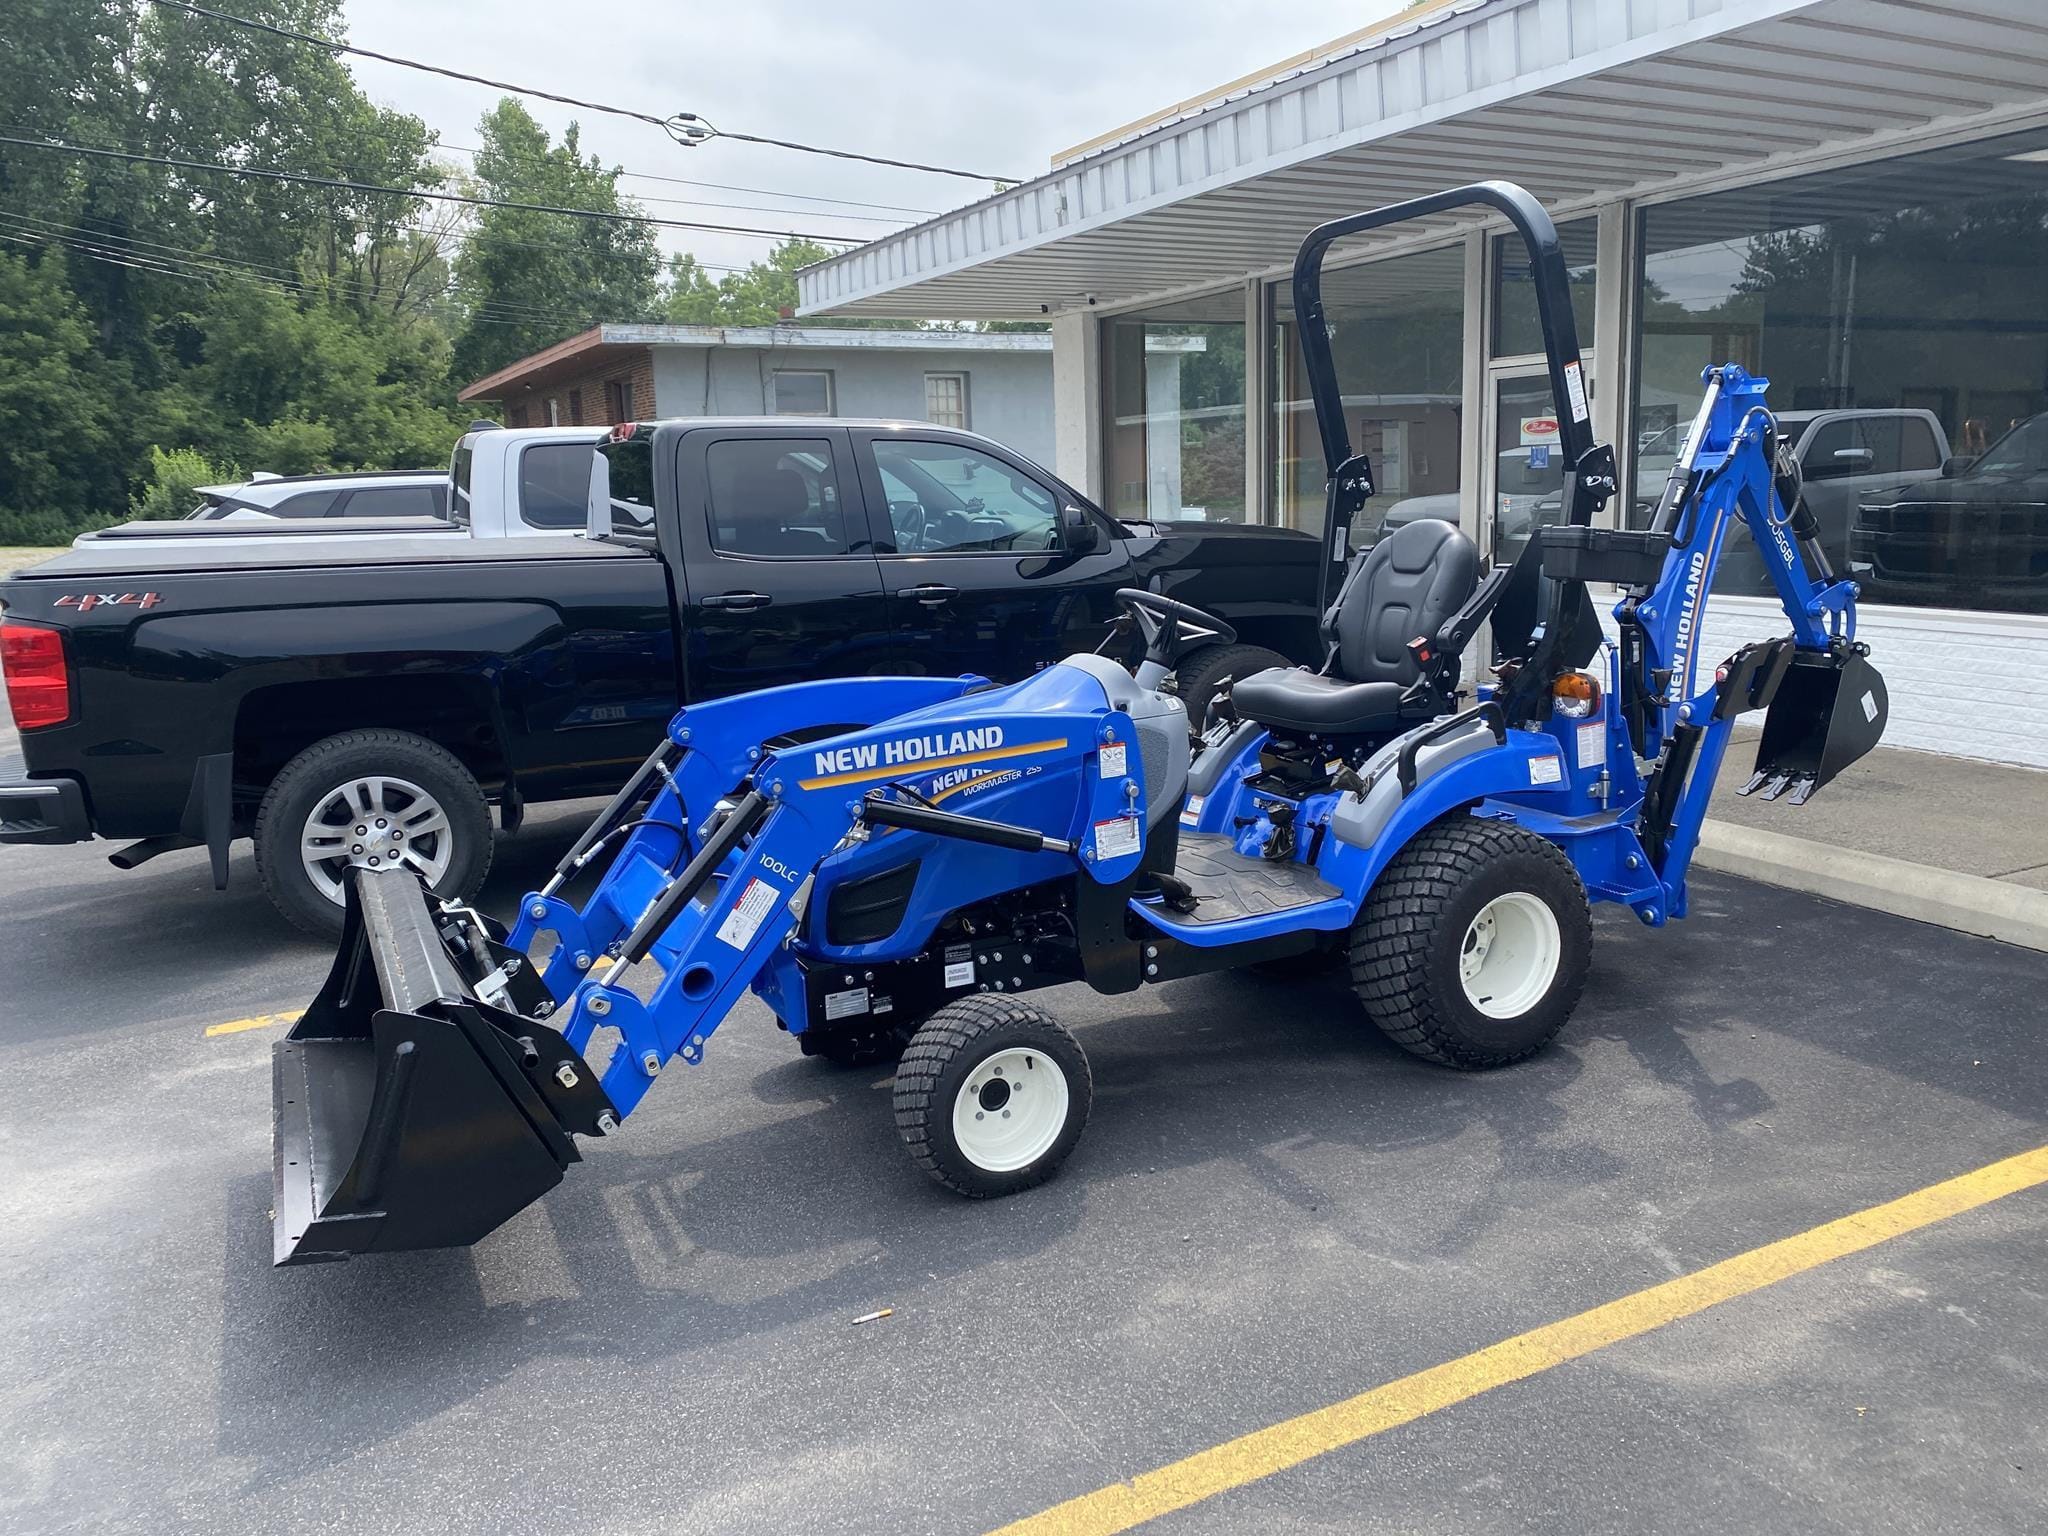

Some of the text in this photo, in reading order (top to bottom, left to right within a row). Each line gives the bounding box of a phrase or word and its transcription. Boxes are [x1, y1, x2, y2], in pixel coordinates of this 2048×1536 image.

[1669, 551, 1705, 703] NEW HOLLAND
[815, 726, 1004, 776] NEW HOLLAND
[932, 768, 968, 795] NEW
[963, 770, 1022, 797] WORKMASTER
[759, 853, 799, 883] 100LC
